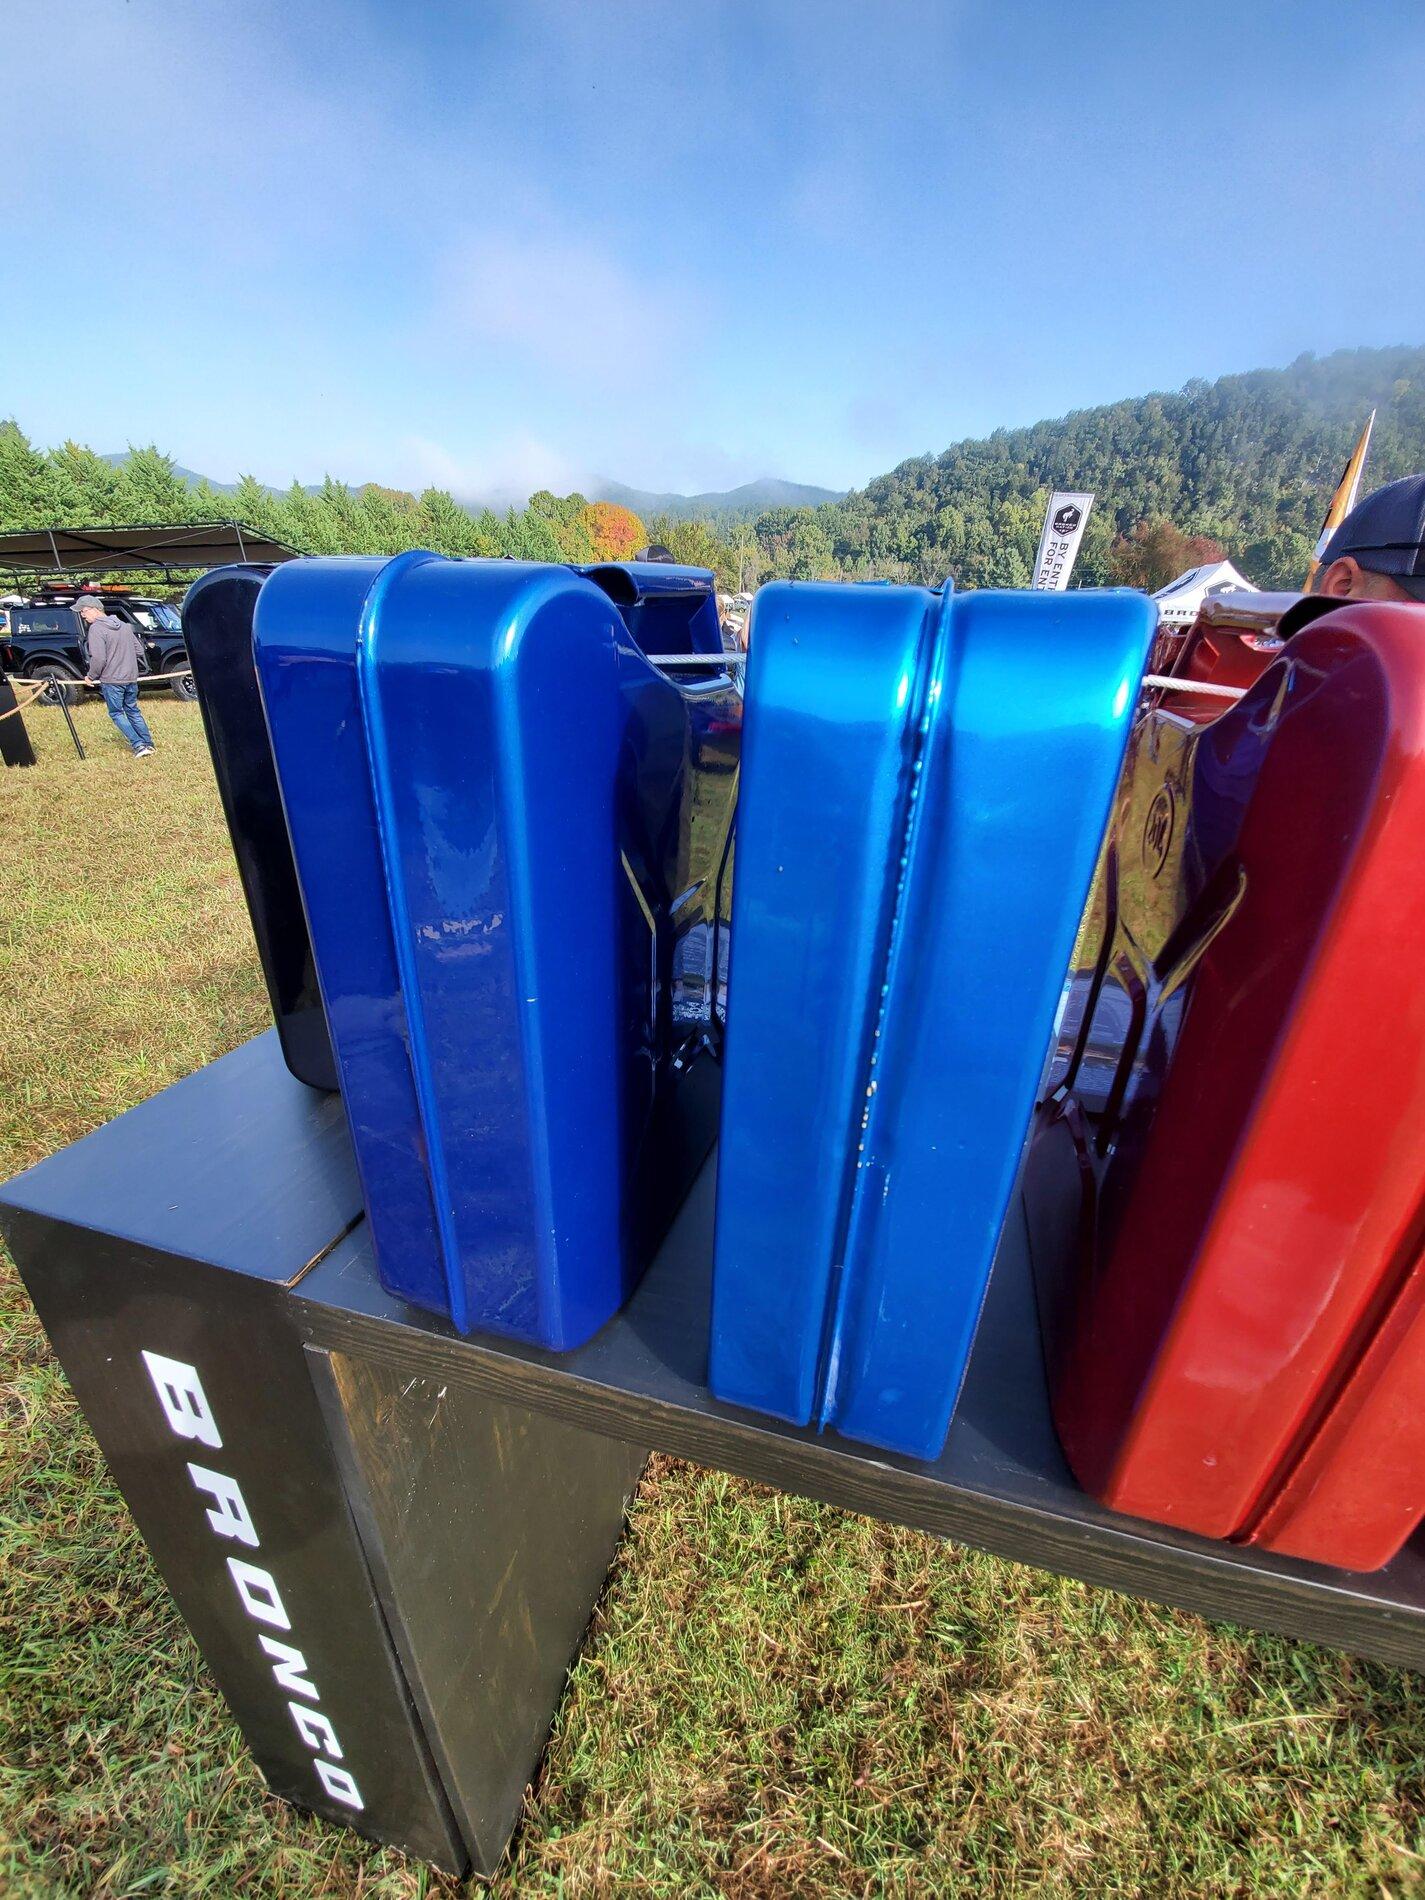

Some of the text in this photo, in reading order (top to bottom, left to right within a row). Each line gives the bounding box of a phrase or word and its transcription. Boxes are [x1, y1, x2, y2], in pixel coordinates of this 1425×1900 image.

[1044, 541, 1058, 566] FOR
[1058, 542, 1069, 559] BY
[142, 1349, 364, 1810] BRONCO
